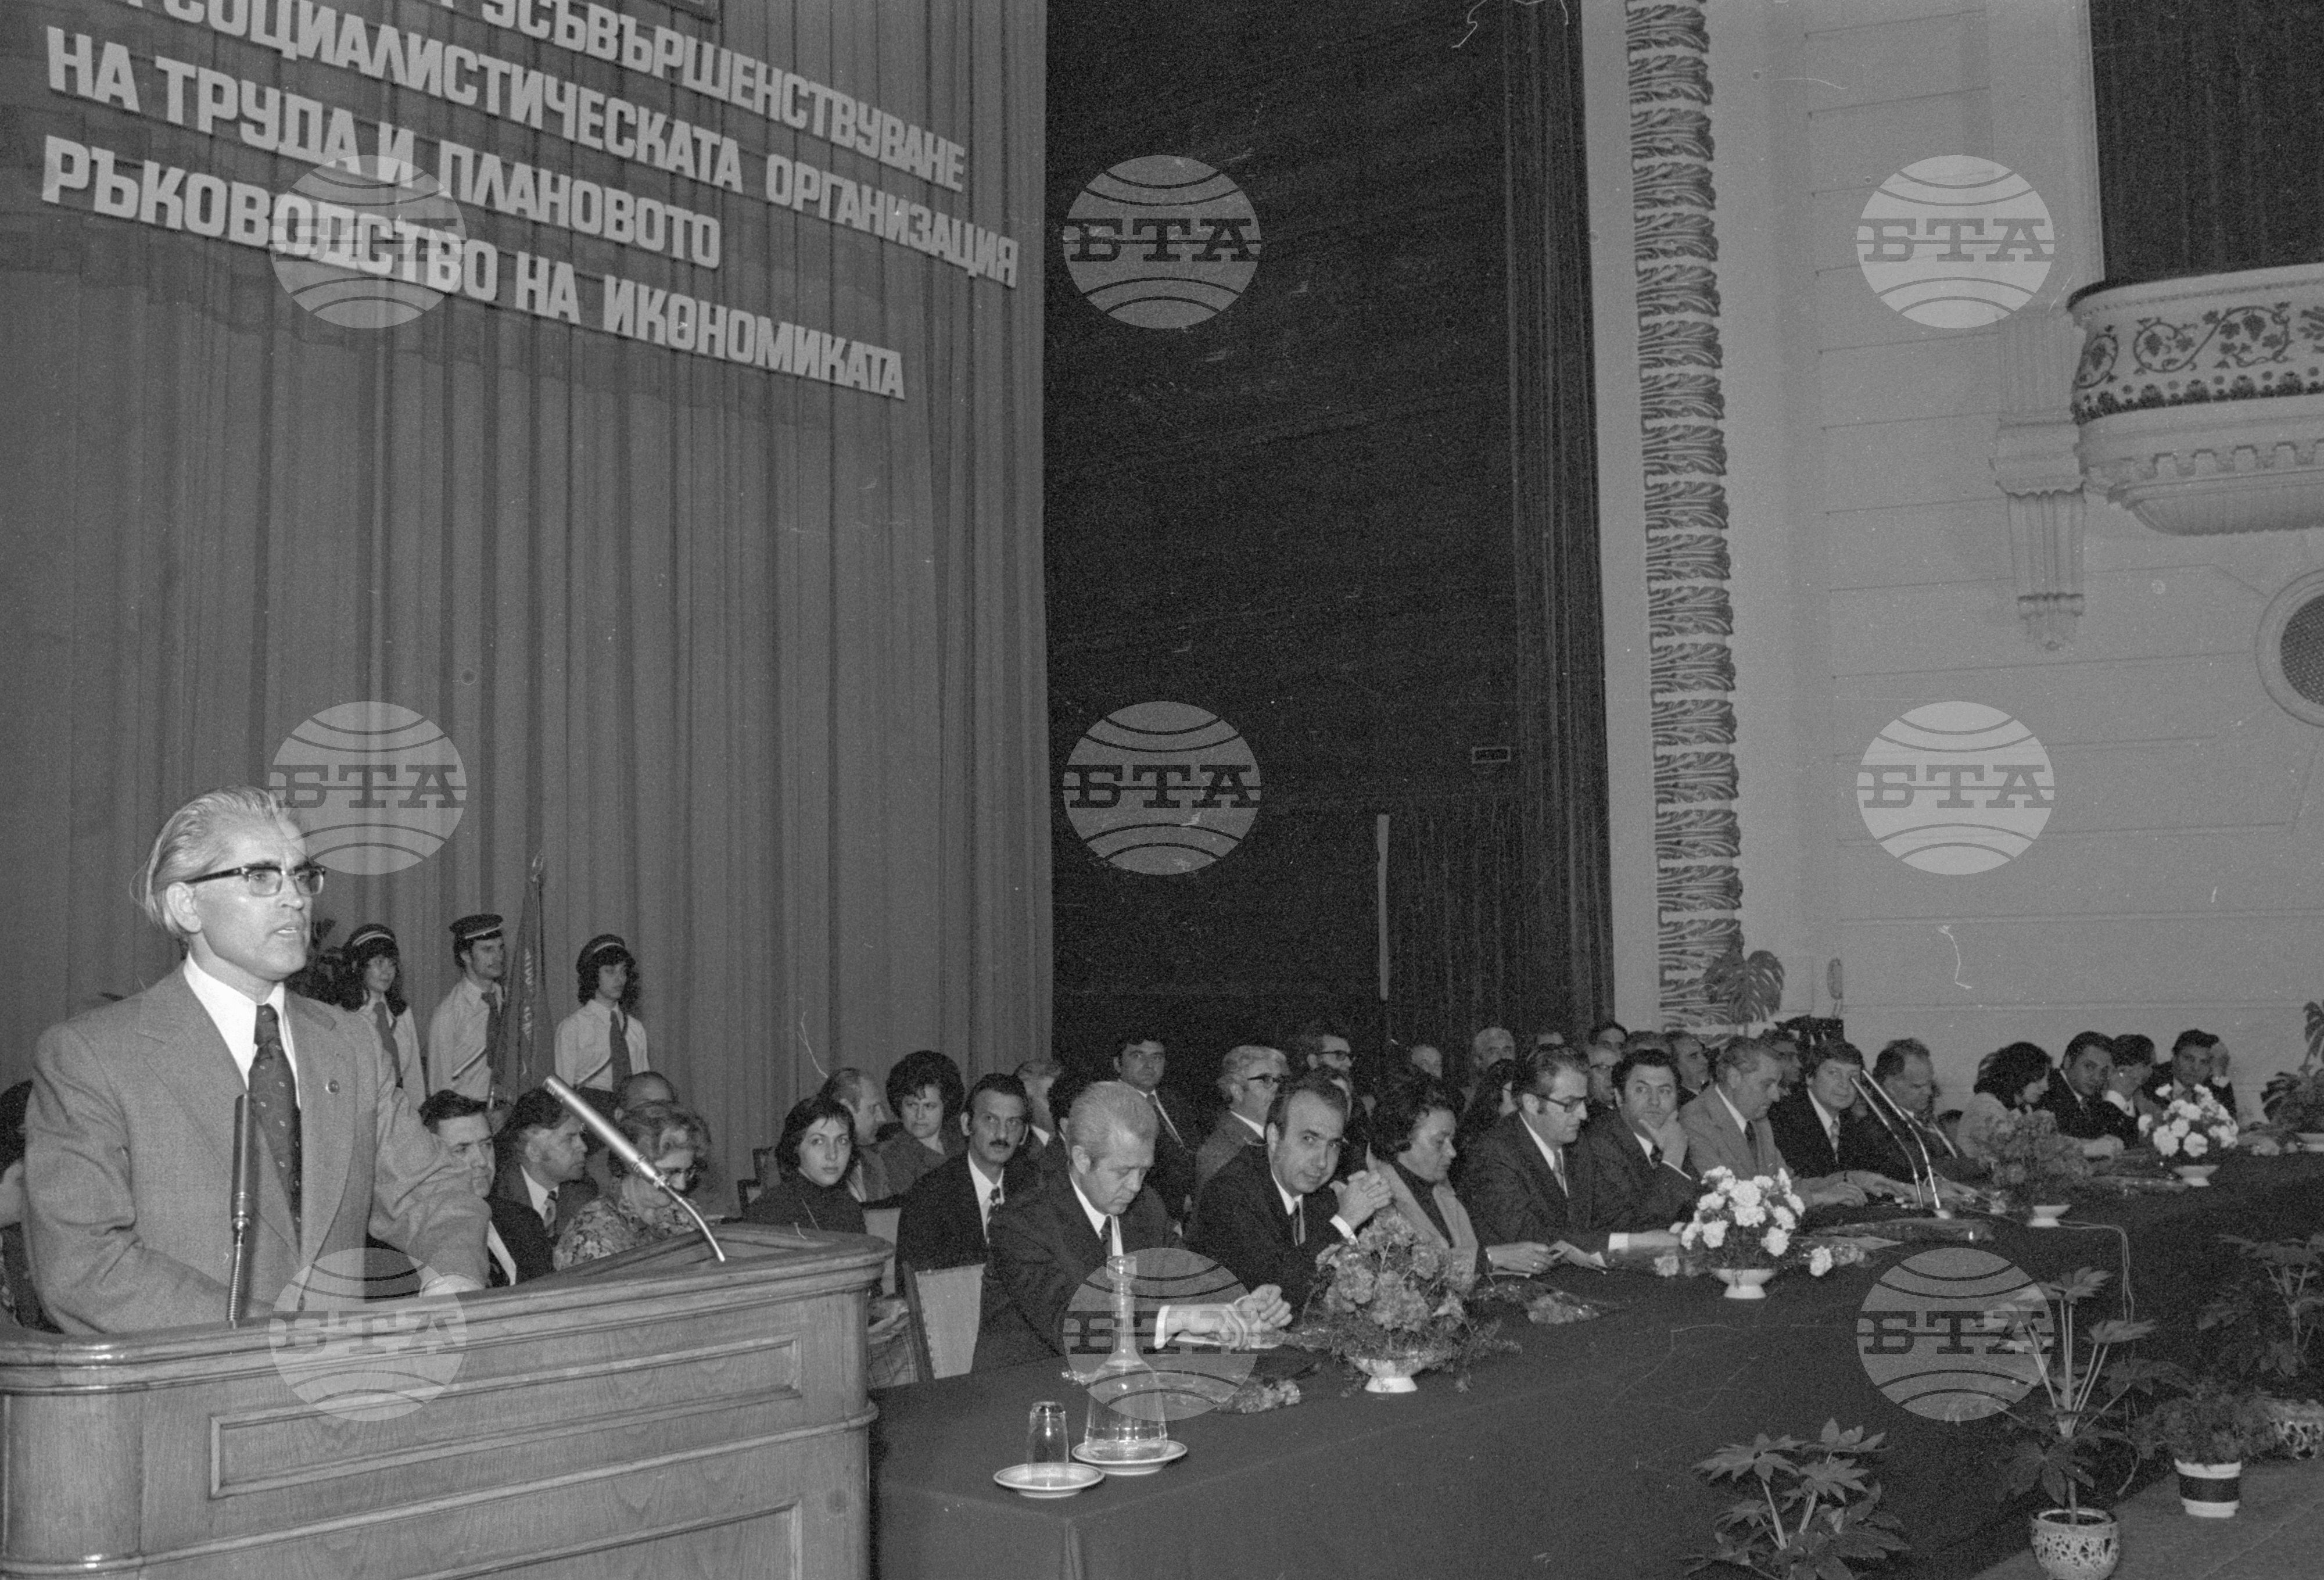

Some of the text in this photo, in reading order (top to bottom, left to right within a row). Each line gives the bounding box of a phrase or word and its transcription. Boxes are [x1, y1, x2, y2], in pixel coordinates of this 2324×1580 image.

[41, 135, 905, 400] РЪКОВОДСТВО НА ИКОНОМИКАТА
[46, 26, 720, 268] НА ТРУДА И ПЛАНОВОТО
[766, 154, 1018, 288] ОРГАНИЗАЦИЯ
